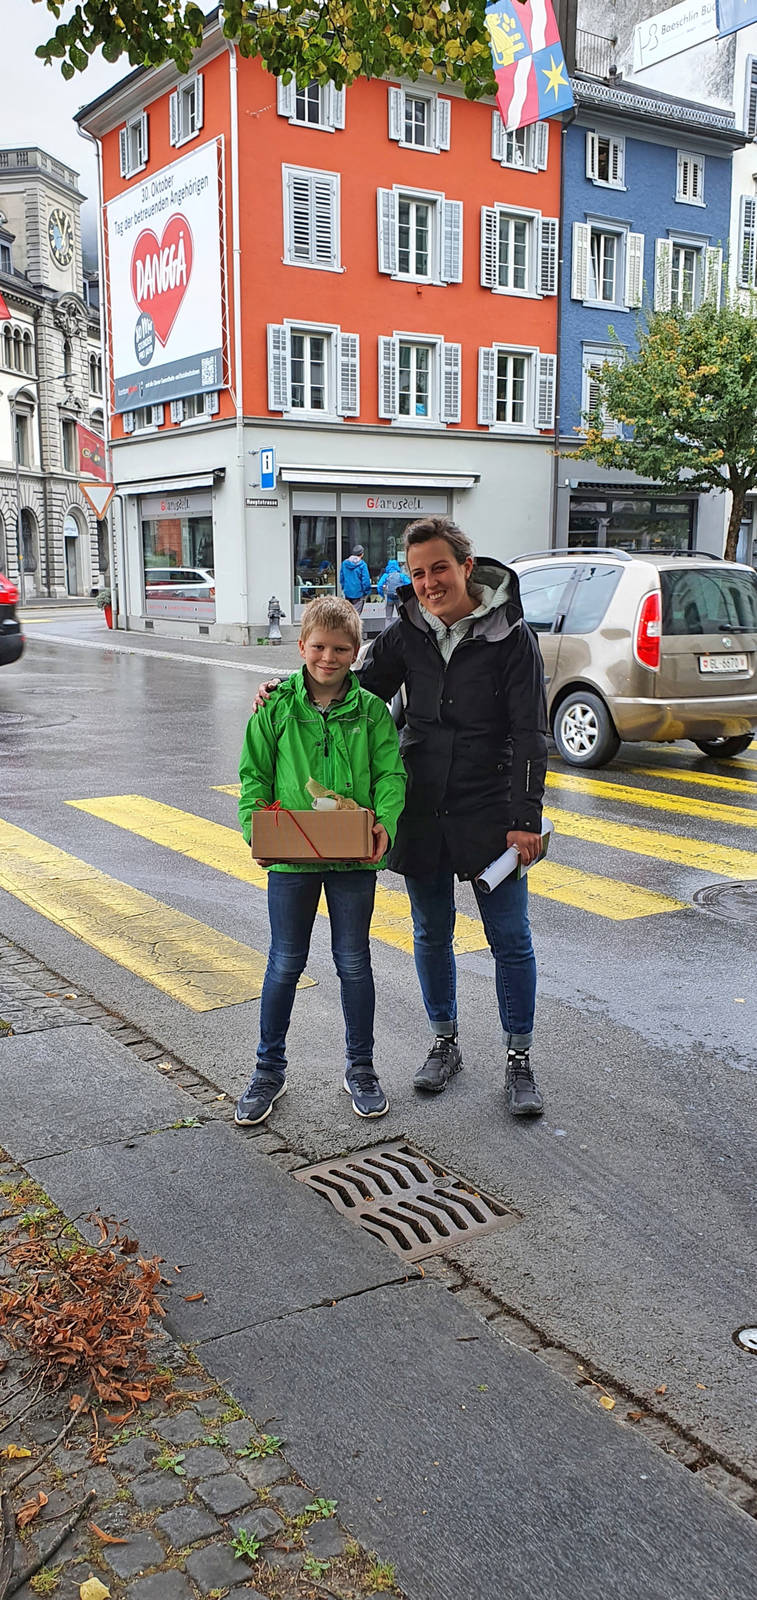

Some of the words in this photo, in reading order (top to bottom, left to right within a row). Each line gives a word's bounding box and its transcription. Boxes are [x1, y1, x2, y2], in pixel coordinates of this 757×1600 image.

[661, 10, 699, 35] Baeschlin
[141, 186, 151, 203] 30.
[151, 175, 174, 197] Oktober
[114, 220, 124, 236] Tag
[124, 216, 133, 230] der
[133, 197, 169, 225] betreuenden
[170, 175, 209, 206] Angehörigen
